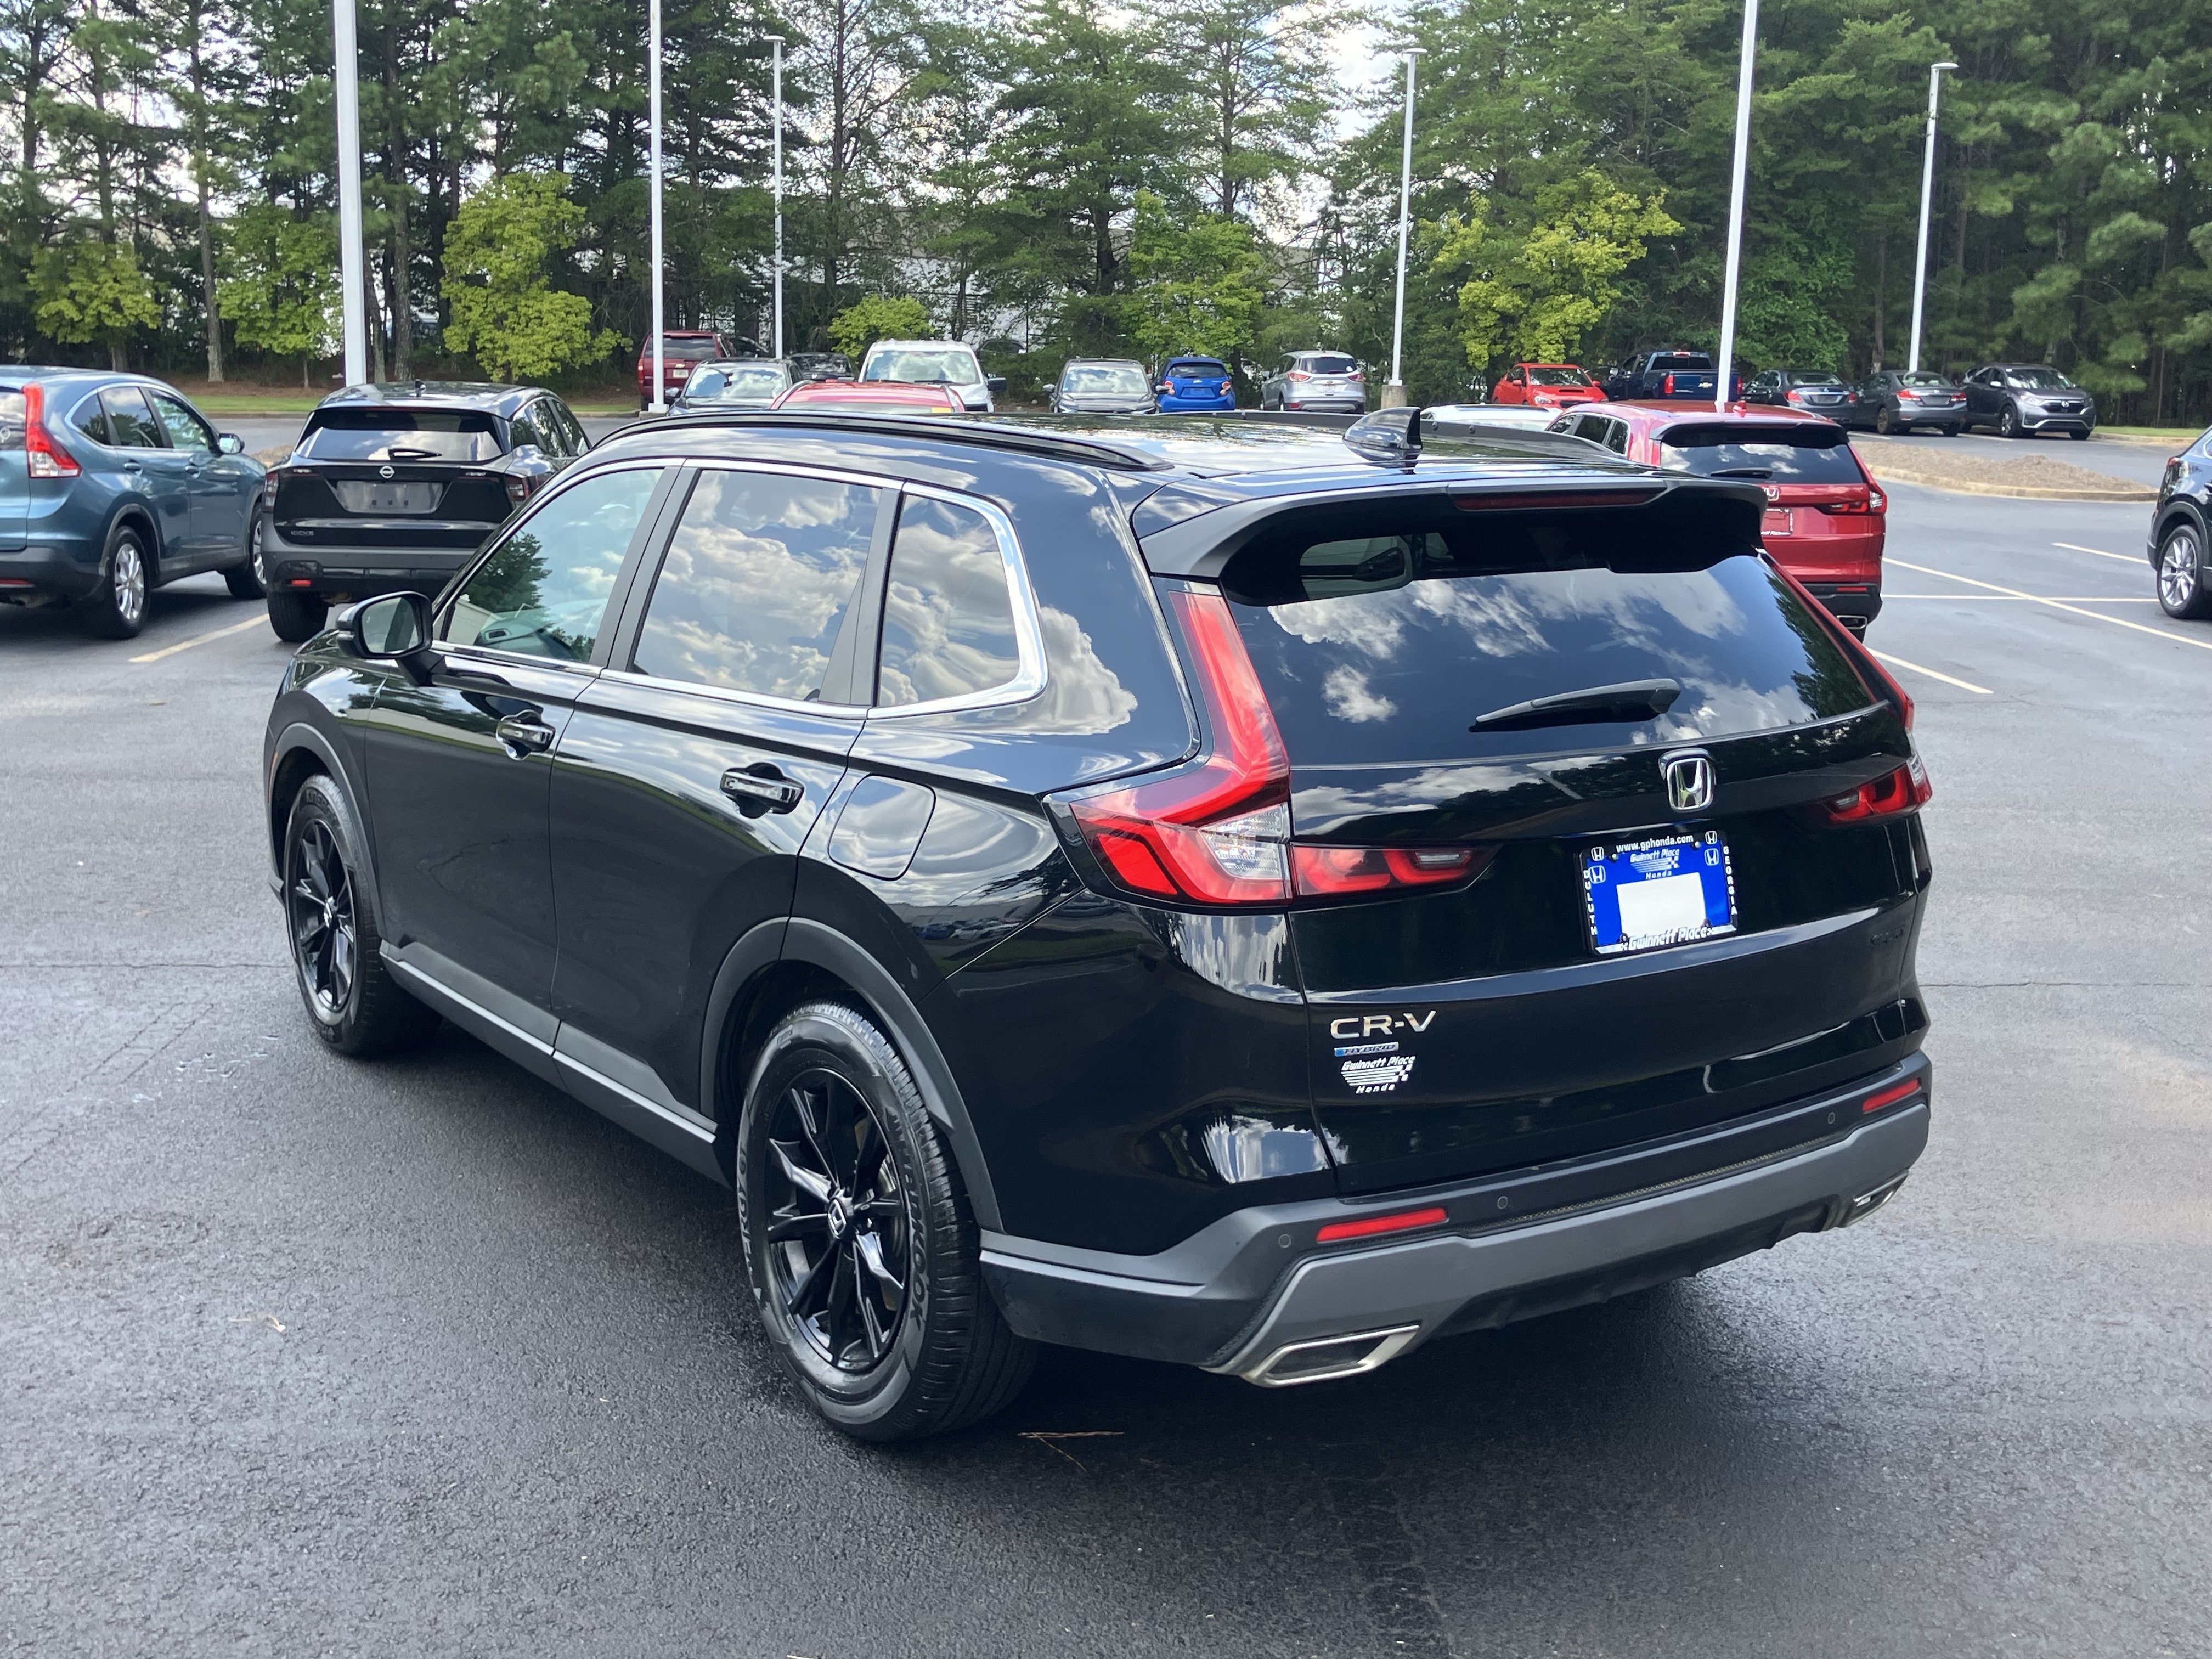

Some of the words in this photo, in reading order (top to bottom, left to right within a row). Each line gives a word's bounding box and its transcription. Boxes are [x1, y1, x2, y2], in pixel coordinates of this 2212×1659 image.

[1616, 834, 1694, 853] www.gphonda.com
[1630, 850, 1660, 862] Gwinnett
[1661, 848, 1680, 859] Place
[1645, 870, 1672, 879] Honda
[1723, 845, 1738, 915] GEORGIA
[1583, 870, 1598, 936] DULUTH
[1628, 929, 1677, 950] Gwinnett
[1677, 926, 1709, 942] Place
[1330, 1010, 1436, 1039] CR-V
[1344, 1044, 1396, 1054] HYBRID
[1341, 1057, 1387, 1071] Gwinnett
[1387, 1056, 1416, 1066] Place
[1356, 1083, 1396, 1094] Honda
